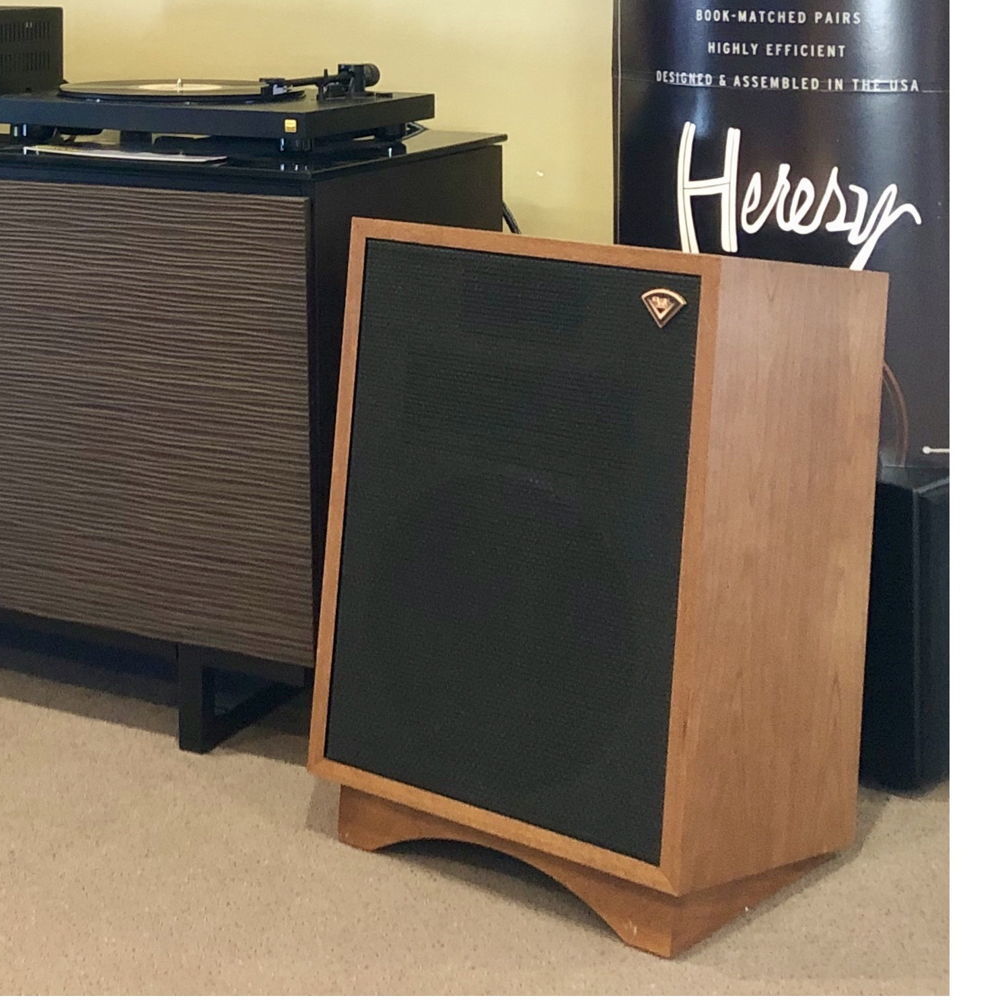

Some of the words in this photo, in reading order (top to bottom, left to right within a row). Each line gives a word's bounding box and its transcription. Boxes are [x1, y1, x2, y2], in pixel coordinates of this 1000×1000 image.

[696, 9, 807, 24] BOOK-MATCHED
[815, 12, 861, 25] PAIRS
[708, 42, 759, 56] HIGHLY
[766, 43, 846, 58] EFFICIENT
[656, 70, 712, 87] DESIGNED
[719, 74, 727, 86] &
[733, 75, 820, 91] ASSEMBLED
[827, 78, 844, 90] IN
[852, 79, 880, 92] THE
[889, 79, 919, 92] USA
[677, 121, 922, 271] Heresy
